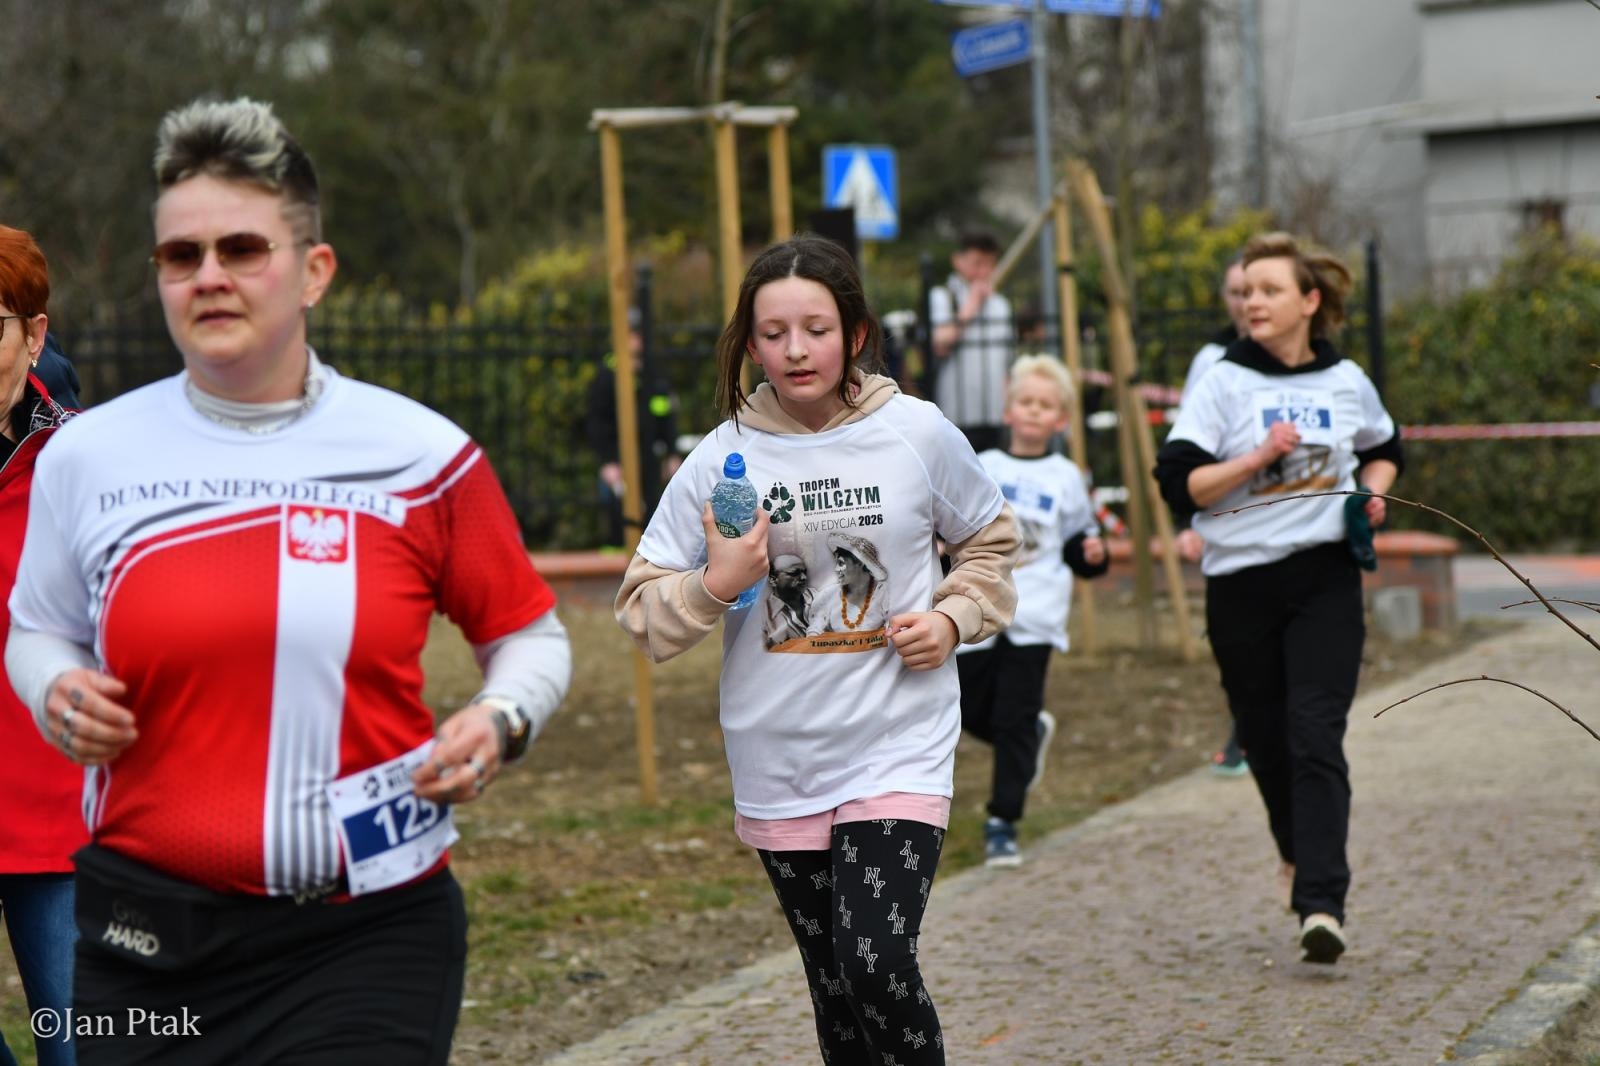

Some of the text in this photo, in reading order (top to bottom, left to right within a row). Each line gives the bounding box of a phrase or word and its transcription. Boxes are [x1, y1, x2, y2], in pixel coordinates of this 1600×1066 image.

[100, 479, 394, 517] DUMNI NIEPODLEGLI
[799, 477, 840, 493] TROPEM
[801, 486, 881, 512] WILCZYM
[803, 513, 884, 533] XIV EDYCJA 2026
[863, 866, 886, 898] NY
[102, 921, 160, 956] HARD
[856, 936, 879, 973] NY
